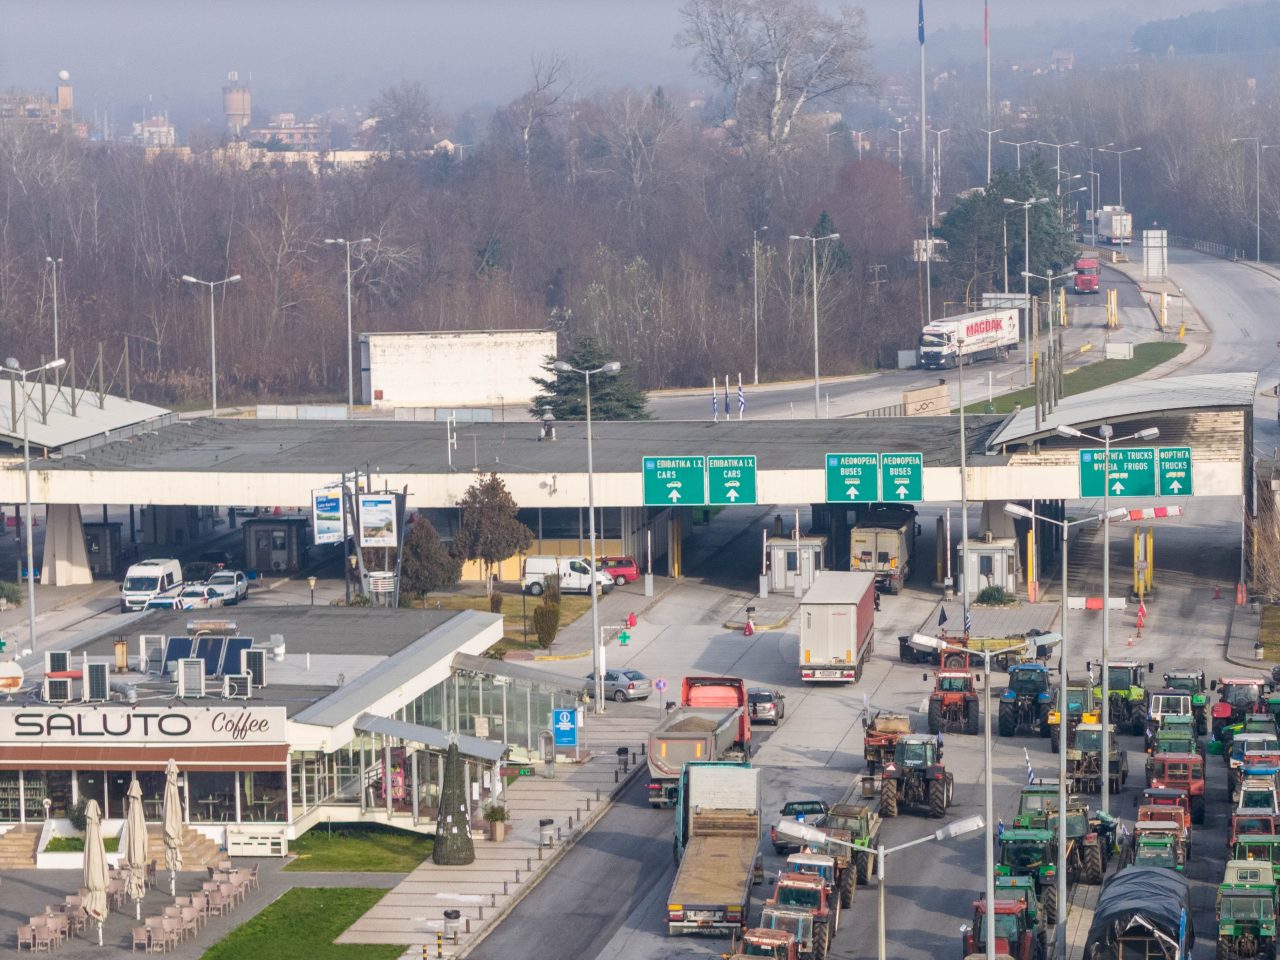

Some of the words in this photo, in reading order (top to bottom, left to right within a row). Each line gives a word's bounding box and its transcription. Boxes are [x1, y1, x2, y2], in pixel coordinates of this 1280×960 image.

[1127, 451, 1153, 460] TRUCKS
[1123, 463, 1148, 471] FRIGOS
[1161, 461, 1188, 470] TRUCKS
[657, 471, 677, 479] CARS
[723, 470, 742, 478] CARS
[840, 468, 862, 476] BUSES
[889, 467, 912, 476] BUSES
[14, 713, 192, 736] SALUTO
[211, 712, 270, 740] Coffee
